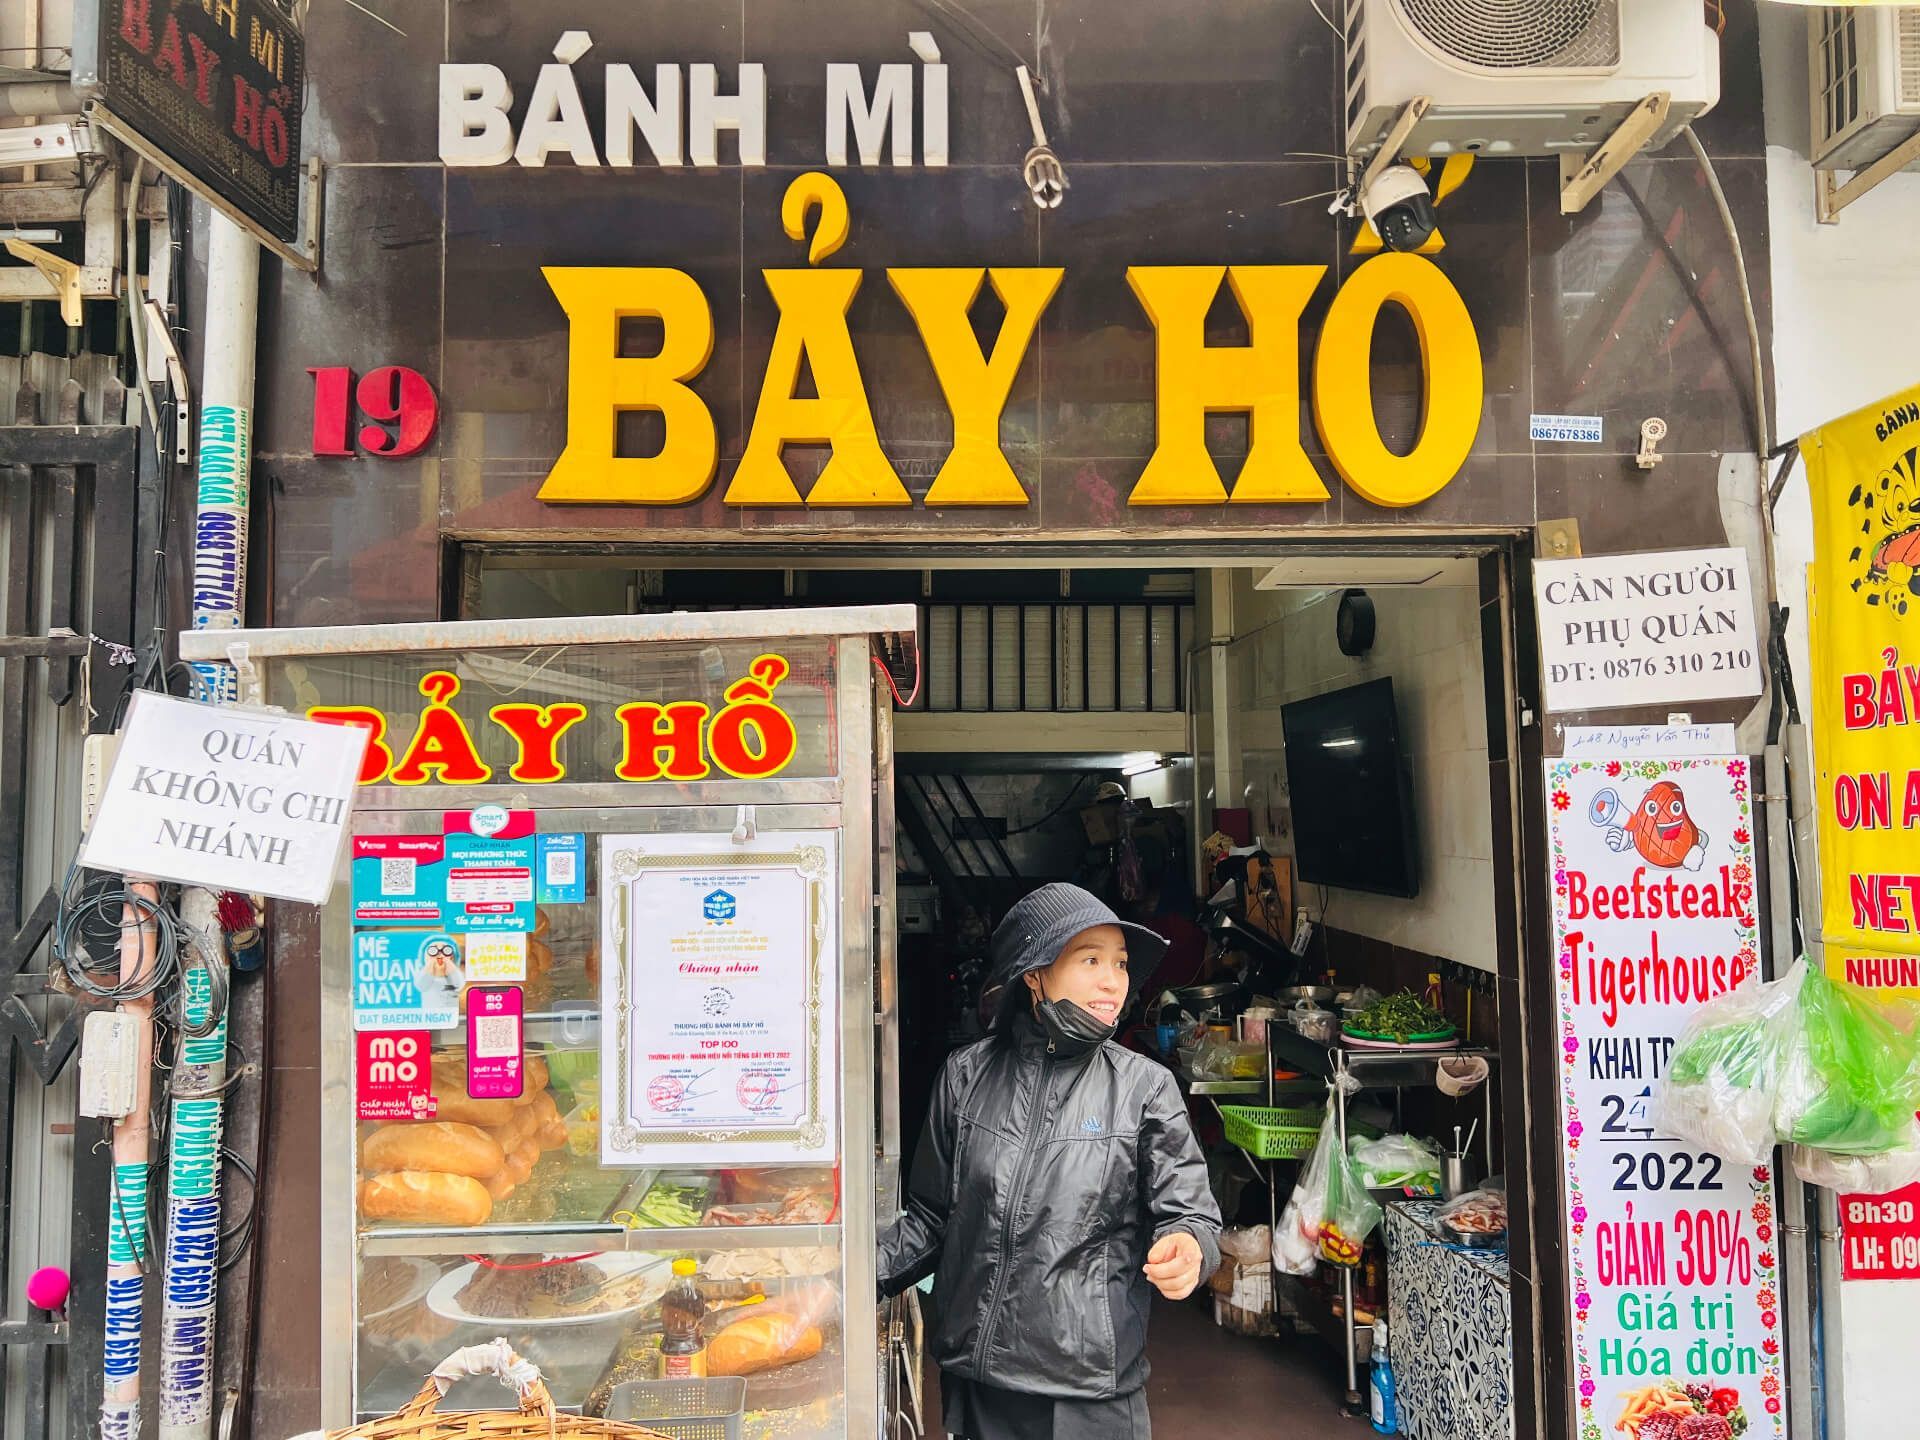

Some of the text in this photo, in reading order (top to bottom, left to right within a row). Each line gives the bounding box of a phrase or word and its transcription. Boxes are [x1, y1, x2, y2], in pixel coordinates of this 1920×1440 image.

[438, 31, 767, 167] BÁNH
[826, 32, 949, 167] MÌ
[536, 172, 1065, 506] BẢY
[306, 366, 438, 457] 19
[198, 406, 236, 505] 0977 040 040
[1531, 427, 1600, 441] 0867678386
[196, 512, 236, 550] 0968
[1625, 561, 1738, 600] NGƯỜI
[1563, 605, 1738, 648] PHỤ QUÁN
[1551, 648, 1752, 684] ĐT: 0876 310 210
[306, 653, 797, 786] BẢY HỔ
[202, 729, 306, 769] QUÁN
[128, 765, 347, 825] KHÔNG CHI
[1834, 771, 1892, 833] ON
[155, 819, 293, 866] NHÁNH
[1566, 865, 1745, 921] Beefsteak
[1850, 874, 1920, 934] NET
[1564, 930, 1745, 1028] Tigerhouse
[1845, 957, 1920, 989] NHUN
[369, 1037, 417, 1058] mo
[700, 1040, 719, 1049] TOP
[1588, 1037, 1642, 1080] KHAI
[369, 1061, 418, 1082] mo
[1612, 1152, 1723, 1190] 2022
[1848, 1201, 1914, 1224] 8h30
[1596, 1201, 1752, 1287] GIẢM 30%
[1851, 1234, 1920, 1271] LH: 09
[1617, 1290, 1735, 1339] Giá trị
[1600, 1337, 1757, 1376] Hóa đơn
